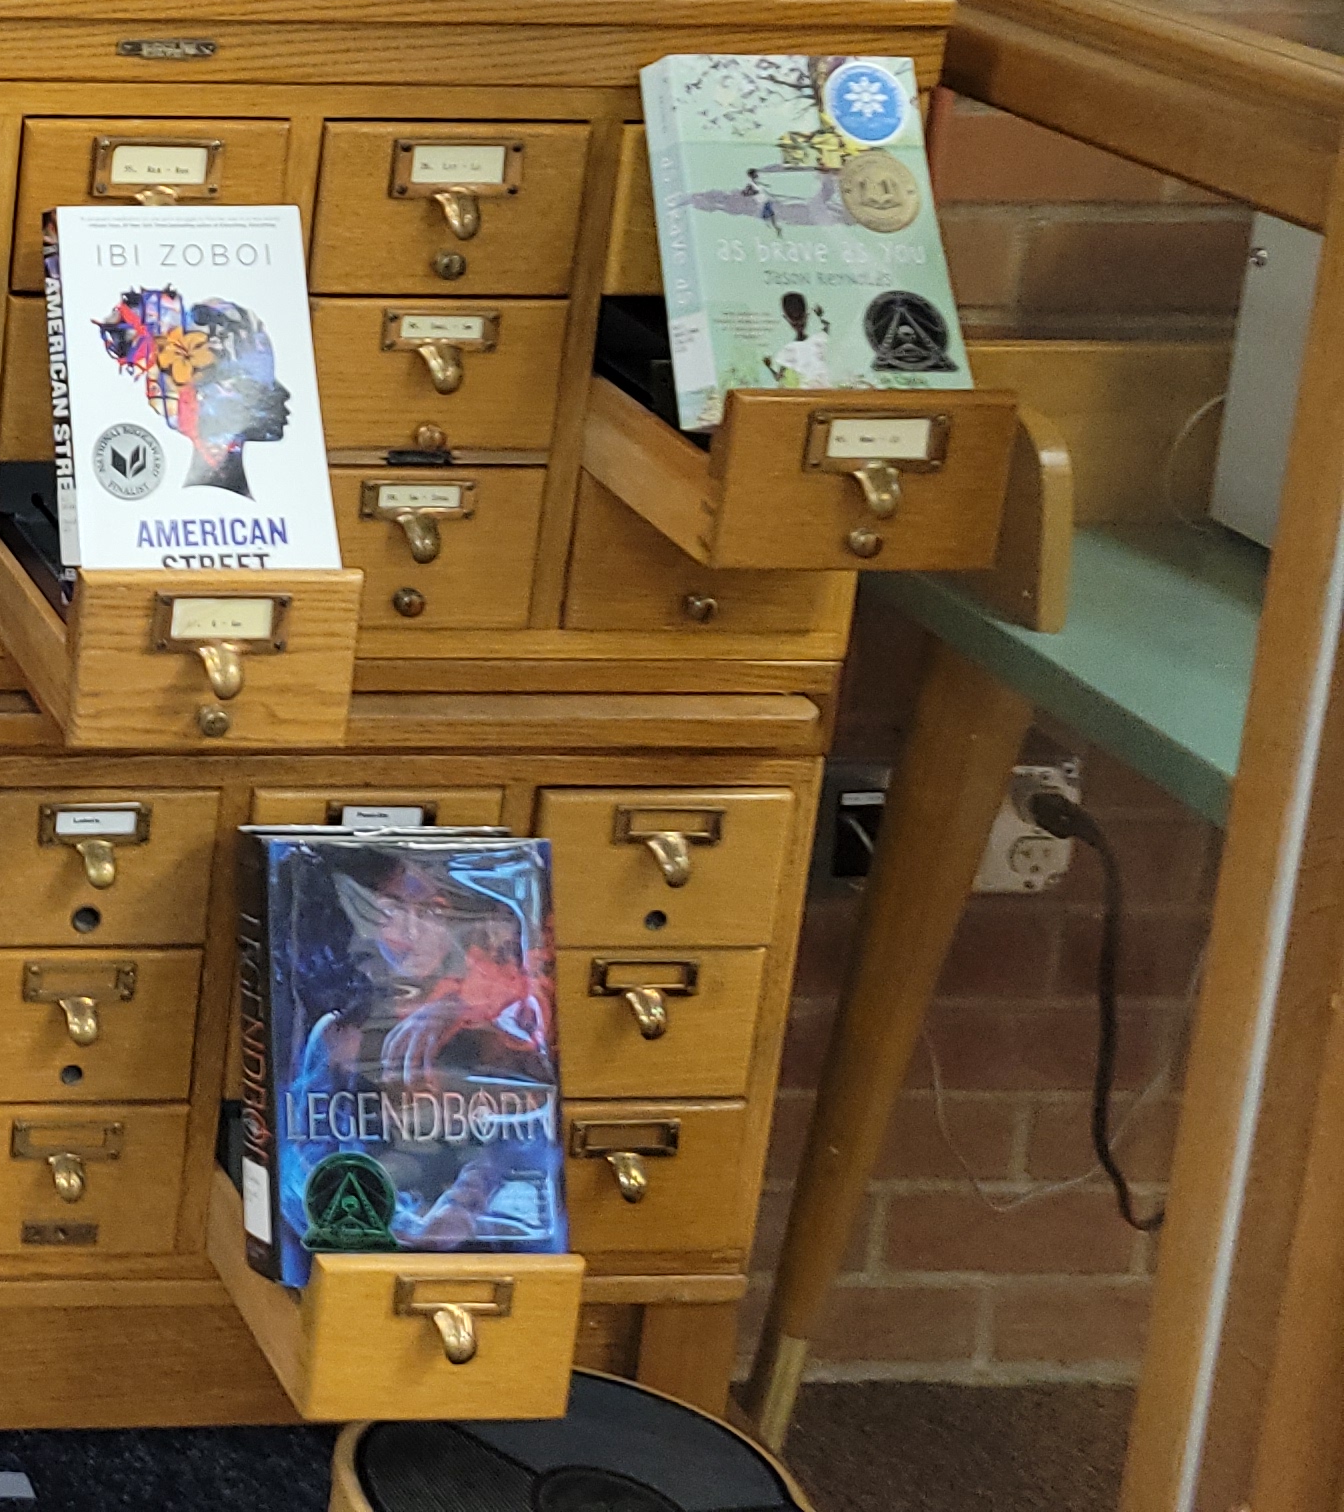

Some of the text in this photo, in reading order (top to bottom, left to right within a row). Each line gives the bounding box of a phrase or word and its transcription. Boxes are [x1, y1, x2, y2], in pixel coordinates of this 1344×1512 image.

[97, 244, 271, 266] IBI ZOBOI
[44, 276, 75, 490] AMERICAN STRE
[136, 517, 289, 548] AMERICAN
[285, 1087, 558, 1143] LEGENDBORN
